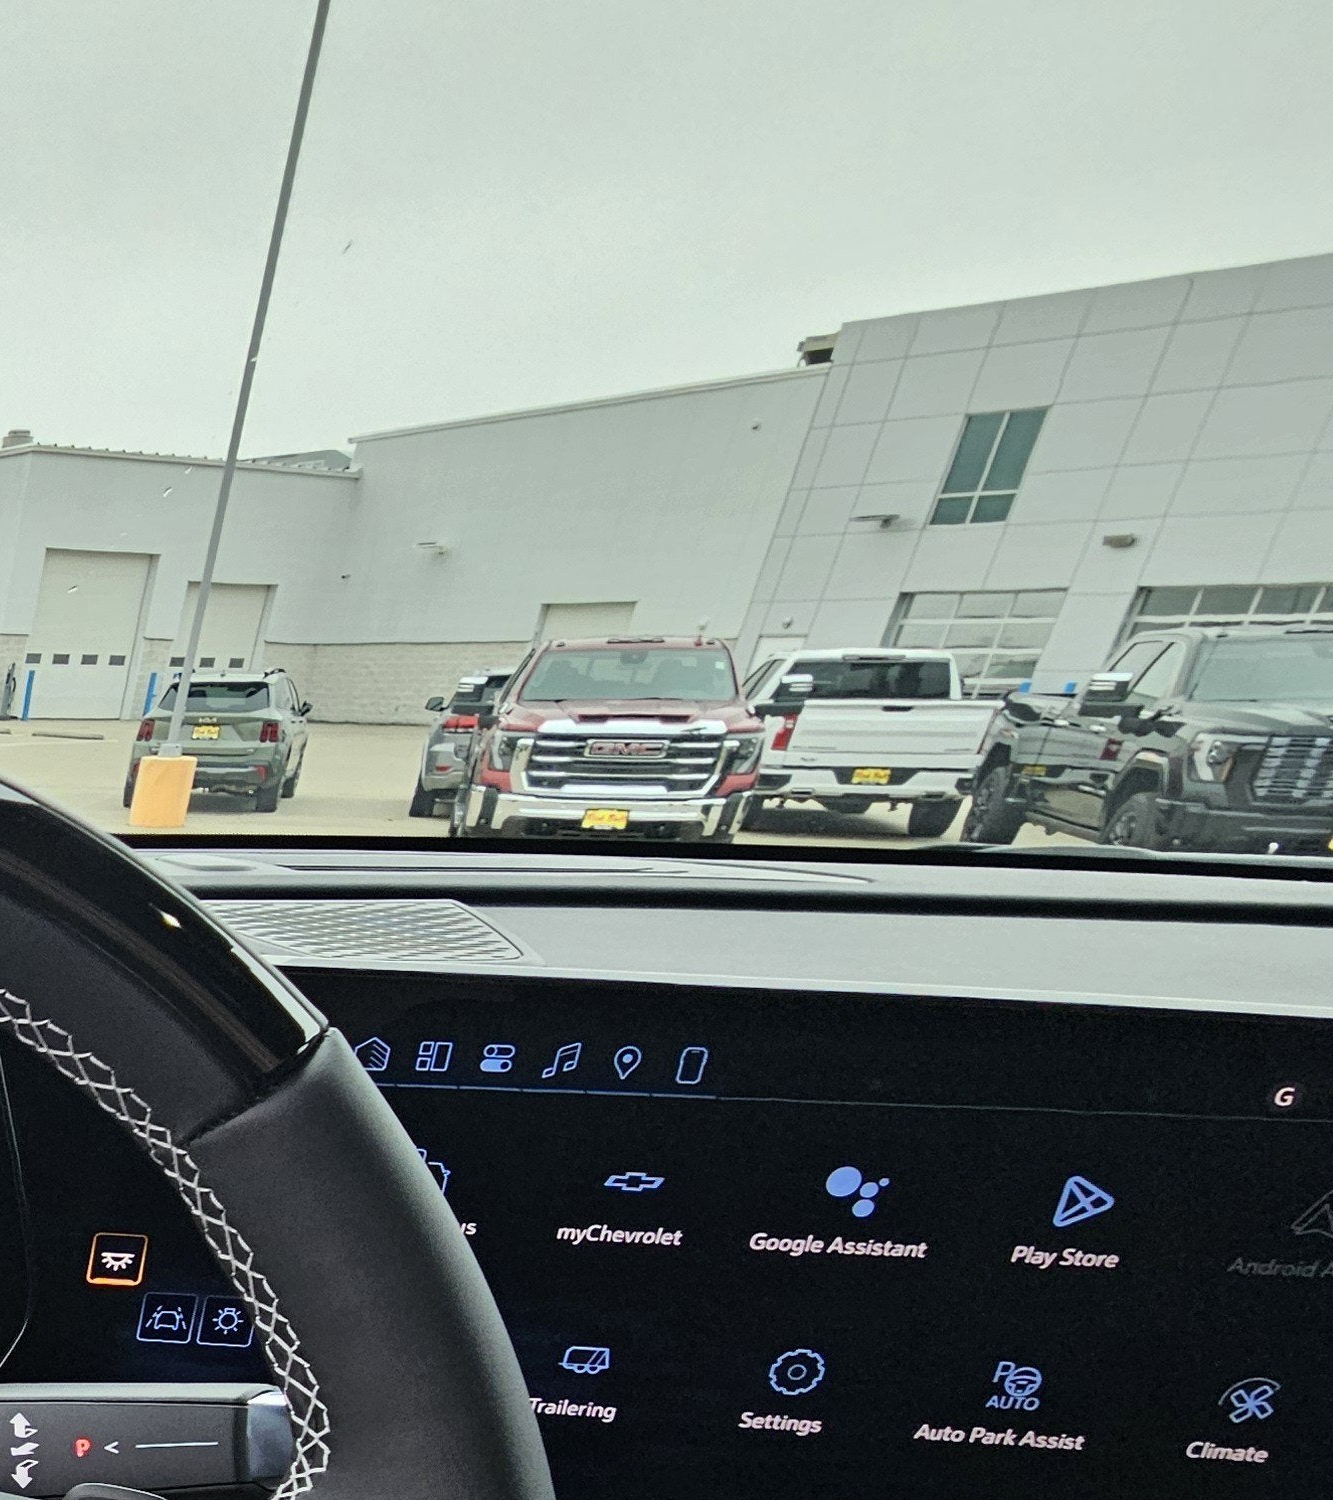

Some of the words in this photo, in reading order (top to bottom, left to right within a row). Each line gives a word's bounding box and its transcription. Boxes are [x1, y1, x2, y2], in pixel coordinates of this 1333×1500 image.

[590, 742, 665, 756] GMC
[557, 1225, 683, 1245] myChevrolet
[750, 1233, 824, 1256] Google
[826, 1237, 927, 1258] Assistant
[1011, 1246, 1057, 1269] Play
[1059, 1248, 1119, 1268] Store
[529, 1398, 617, 1422] Trailering
[985, 1395, 1040, 1411] AUTO
[738, 1412, 822, 1436] Settings
[75, 1439, 91, 1457] P
[913, 1424, 965, 1442] Auto
[969, 1427, 1017, 1445] Park
[1018, 1431, 1085, 1450] Assist
[1186, 1441, 1268, 1463] Climate
